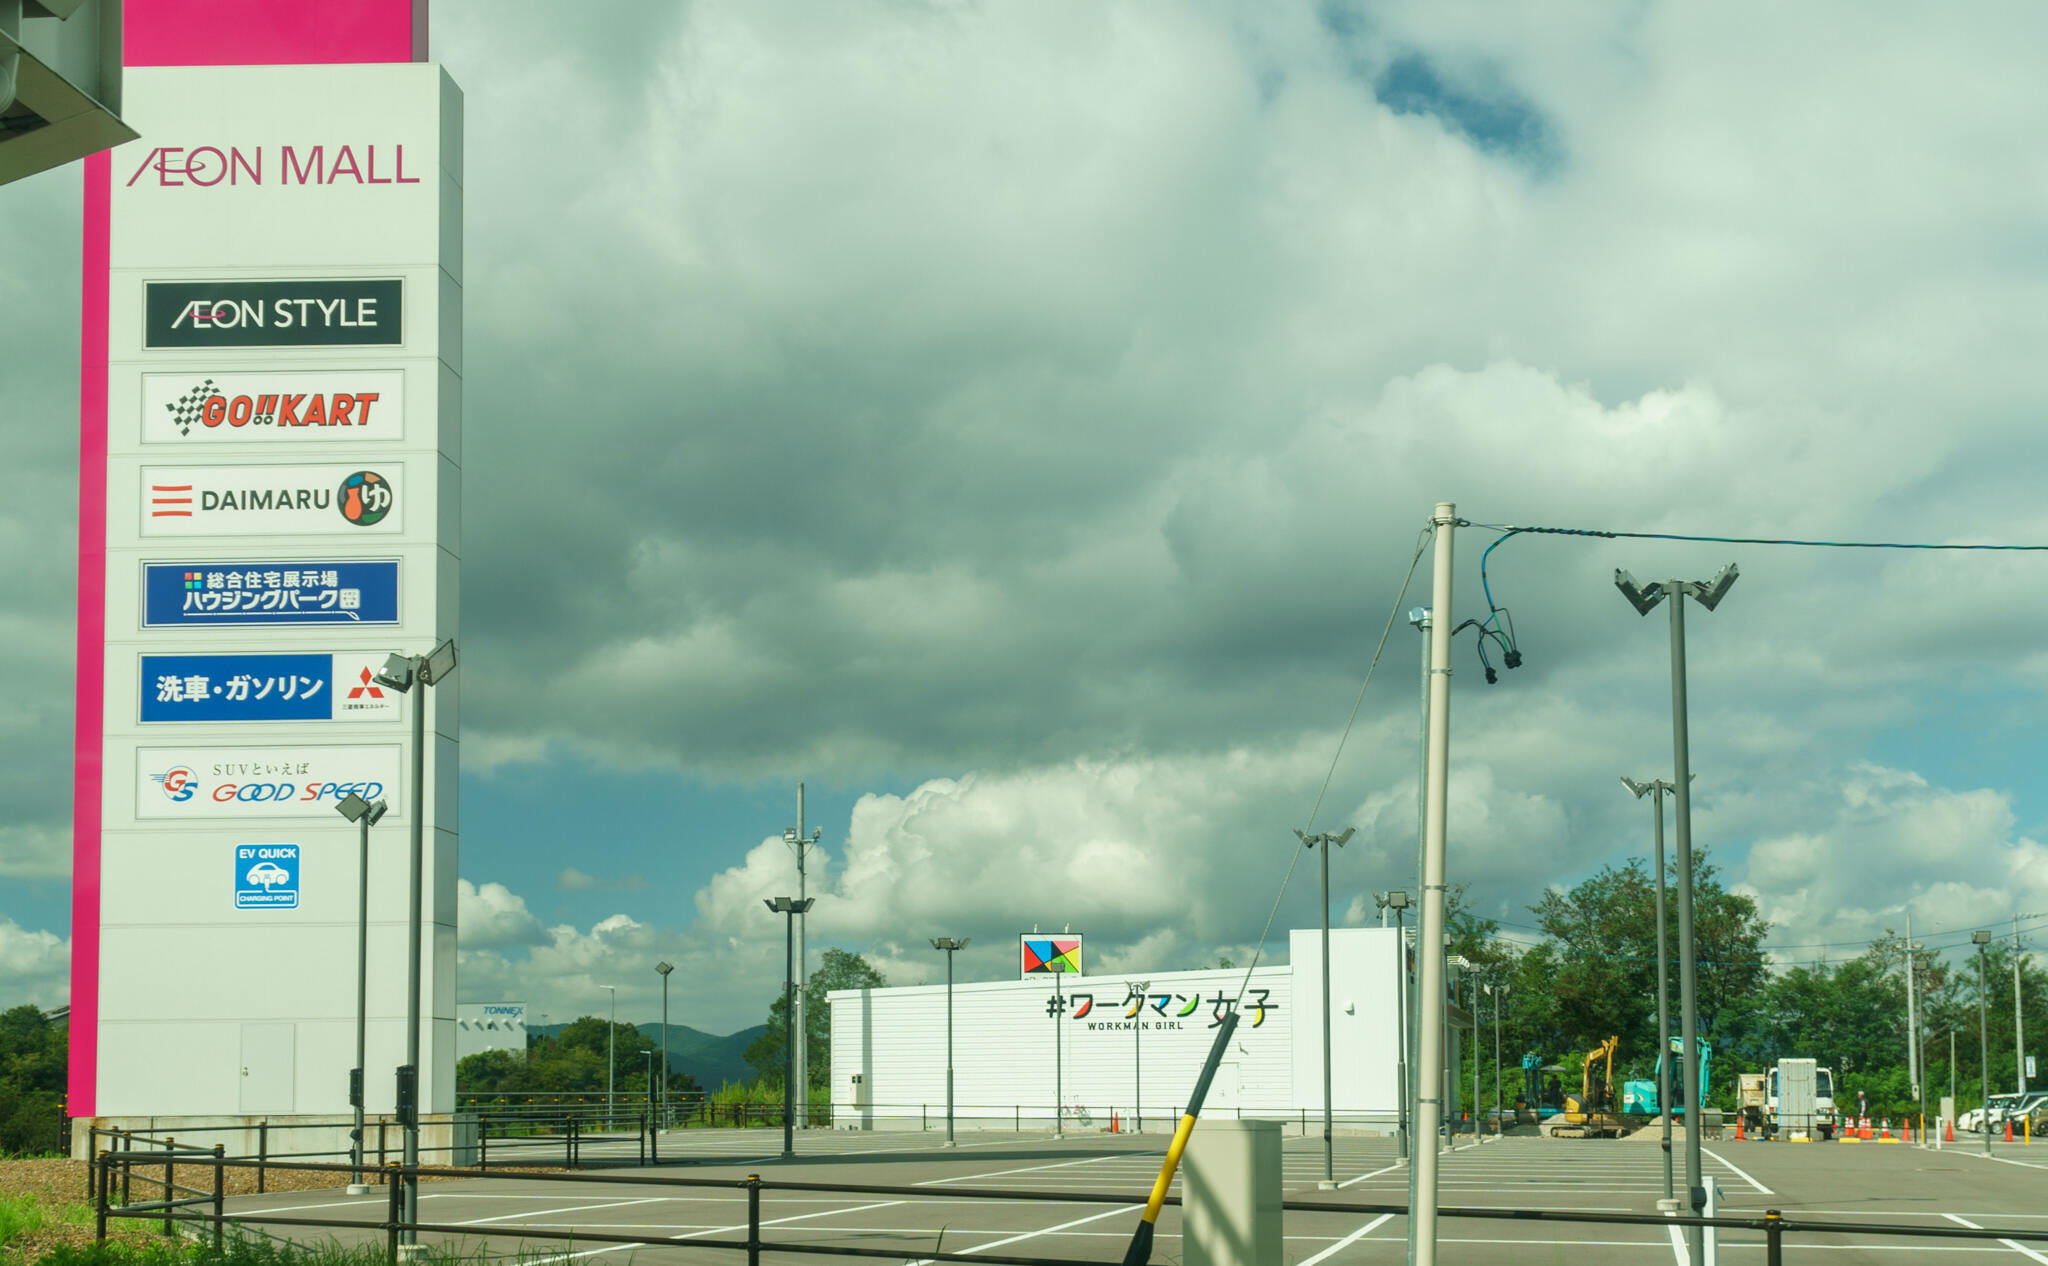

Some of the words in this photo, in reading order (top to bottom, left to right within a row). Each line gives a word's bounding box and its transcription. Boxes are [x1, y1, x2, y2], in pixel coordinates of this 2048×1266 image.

[281, 144, 420, 185] MALL
[274, 298, 377, 327] STYLE
[201, 489, 330, 511] DAIMARU
[361, 484, 391, 513] ゆ
[206, 570, 338, 589] 総合住宅展示場
[183, 589, 338, 610] ハウジングパーク
[156, 675, 324, 702] 洗車・ガソリン
[213, 762, 310, 776] SUVといえば
[212, 783, 295, 802] GOOD
[239, 848, 256, 859] EV
[258, 848, 297, 859] QUICK
[1087, 1021, 1149, 1030] WORKMAN
[1155, 1021, 1184, 1030] GIRL
